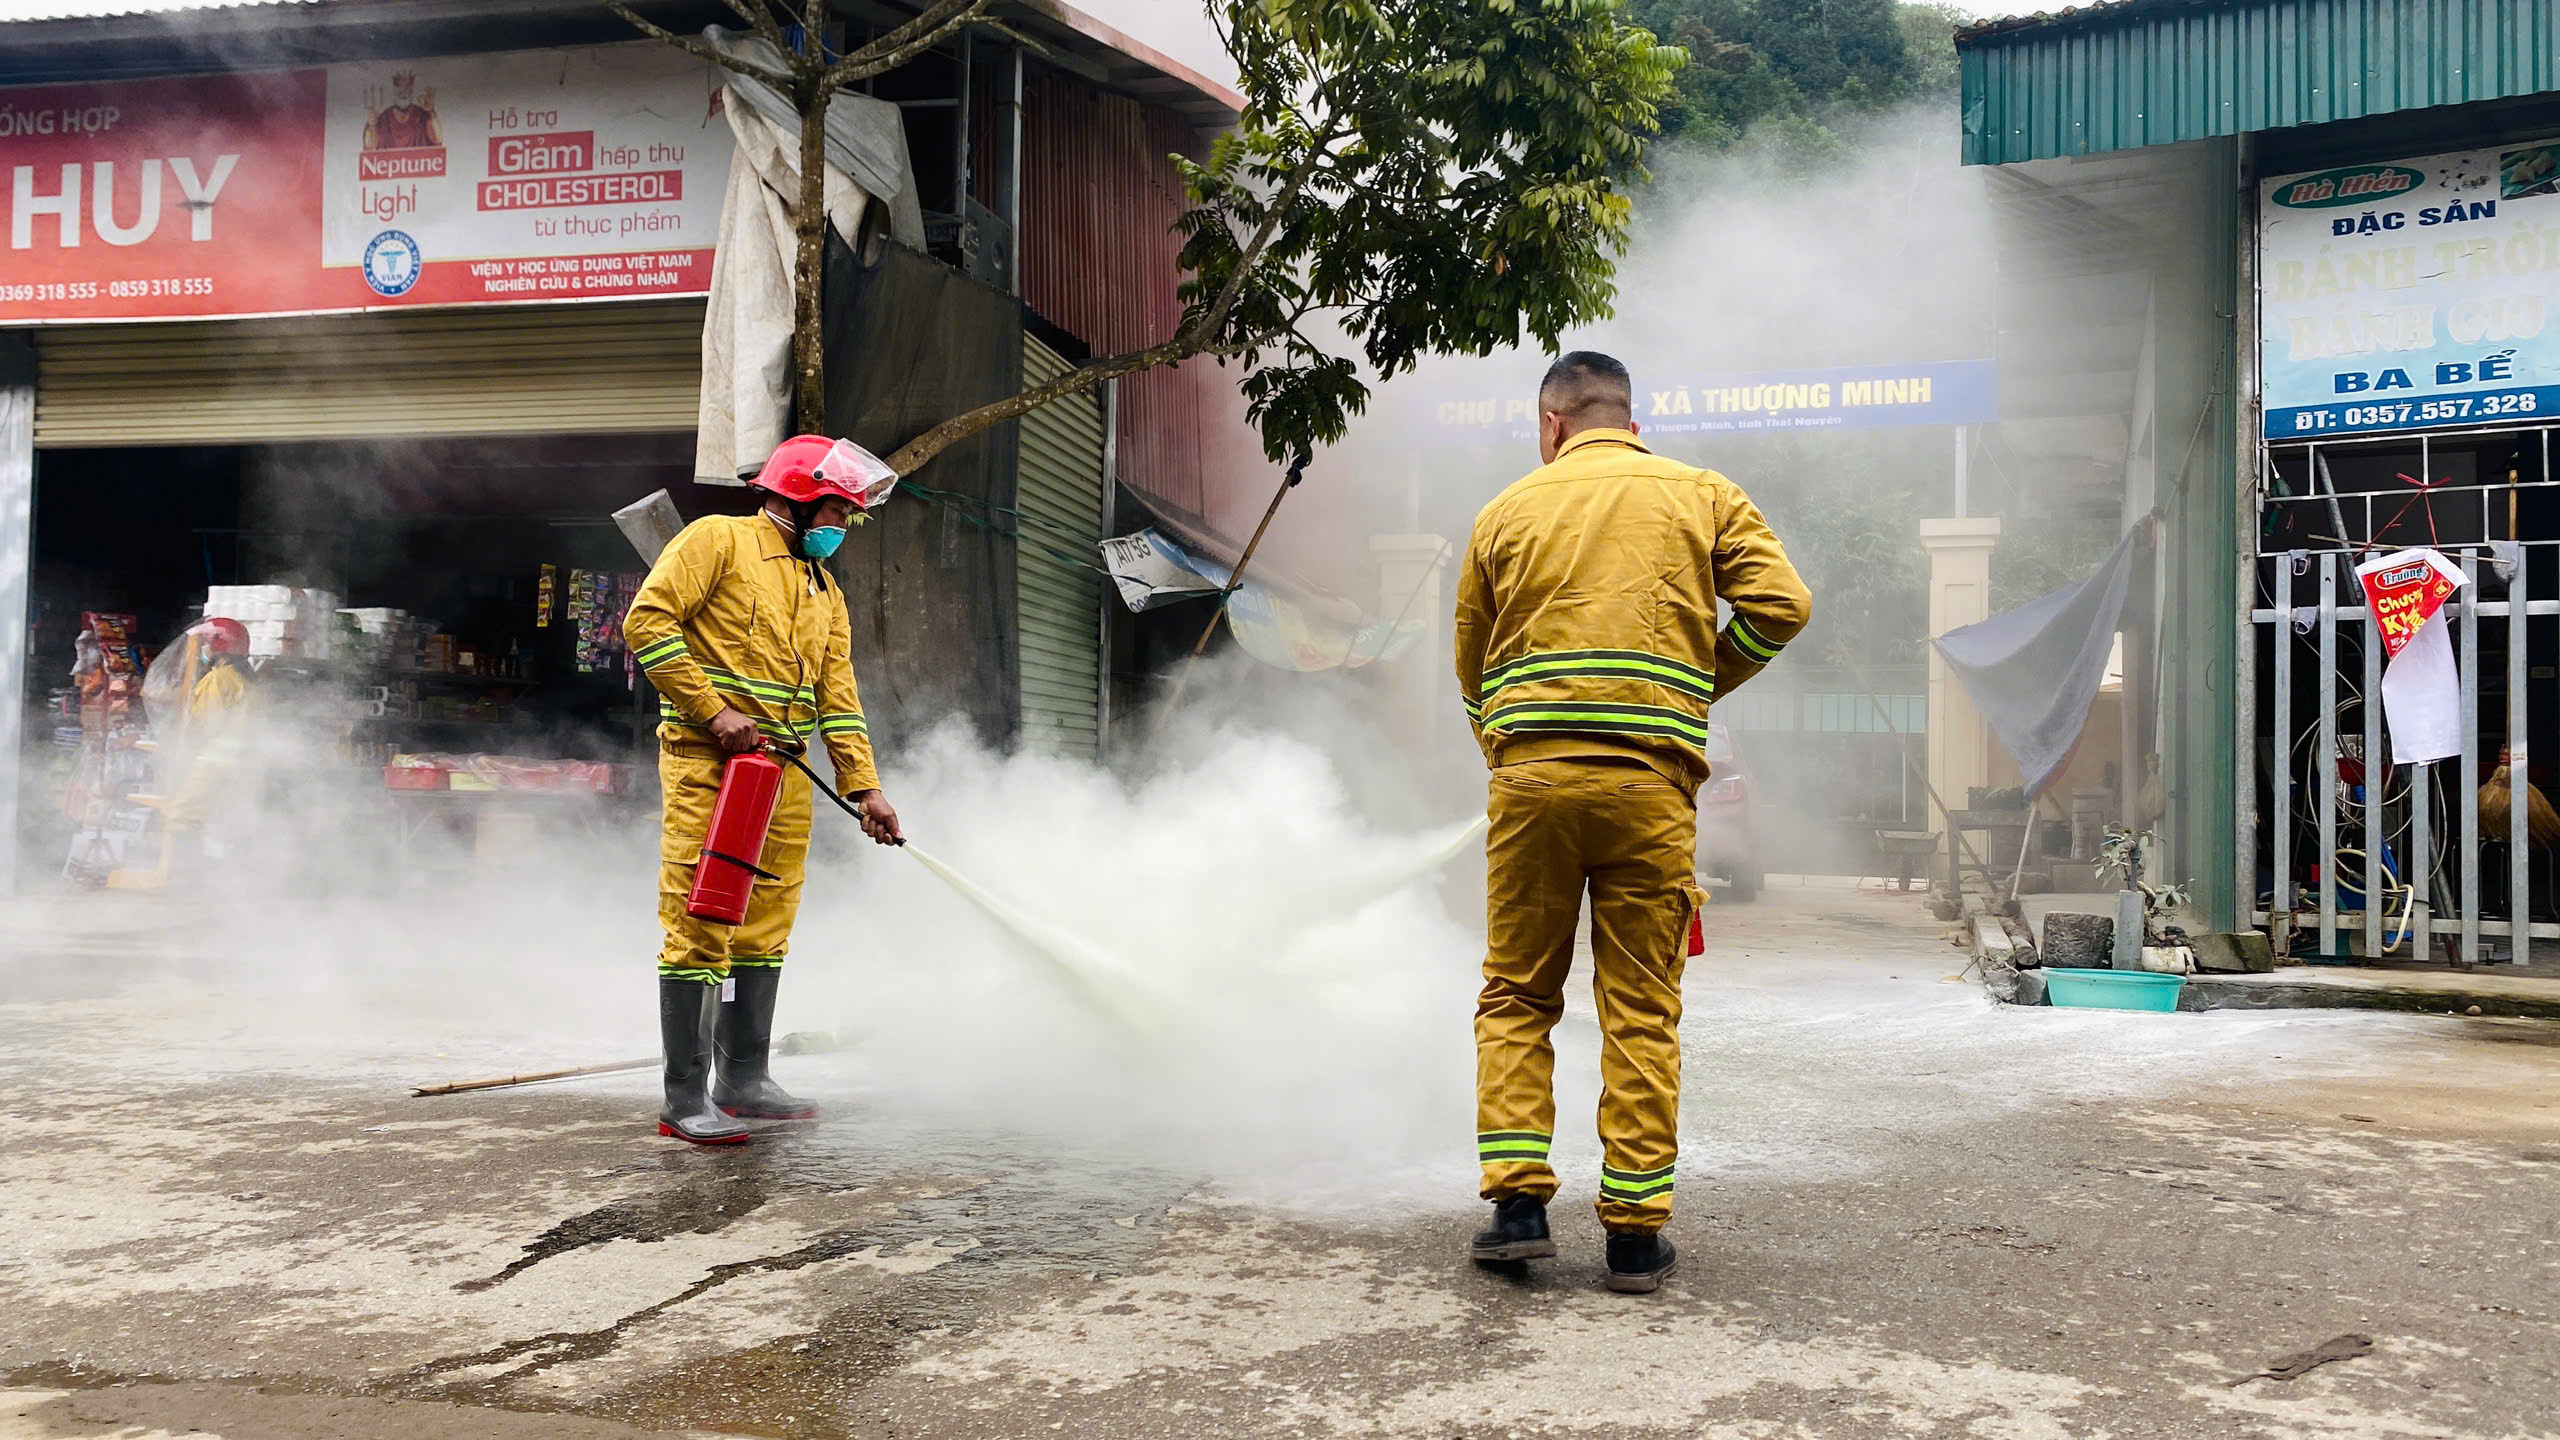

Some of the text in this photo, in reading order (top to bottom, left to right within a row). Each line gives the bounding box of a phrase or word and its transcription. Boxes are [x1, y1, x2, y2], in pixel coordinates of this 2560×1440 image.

[361, 156, 443, 178] Neptune
[500, 136, 685, 173] Giảm hấp thụ
[11, 154, 241, 250] HUY
[362, 184, 418, 222] Light
[485, 175, 674, 208] CHOLESTEROL
[2289, 168, 2411, 204] Hà Hiền
[535, 208, 681, 238] từ thực phẩm
[2332, 199, 2497, 237] ĐẶC SẢN
[471, 260, 503, 278] VIỆN
[505, 262, 515, 275] Y
[518, 261, 547, 276] HỌC
[583, 257, 622, 274] DỤNG
[625, 253, 655, 272] VIỆT
[658, 254, 693, 268] NAM
[485, 276, 537, 292] NGHIÊN
[571, 276, 582, 289] &
[637, 269, 679, 287] NHẬN
[37, 283, 65, 300] 318
[69, 281, 97, 299] 555
[109, 280, 148, 297] 0859
[151, 279, 180, 296] 318
[184, 277, 213, 295] 555
[2334, 349, 2518, 394] BA BỂ
[1651, 385, 1693, 416] XÃ
[1702, 382, 1831, 416] THƯỢNG
[1841, 377, 1932, 407] MINH
[2295, 393, 2537, 430] ĐT: 0357.557.328
